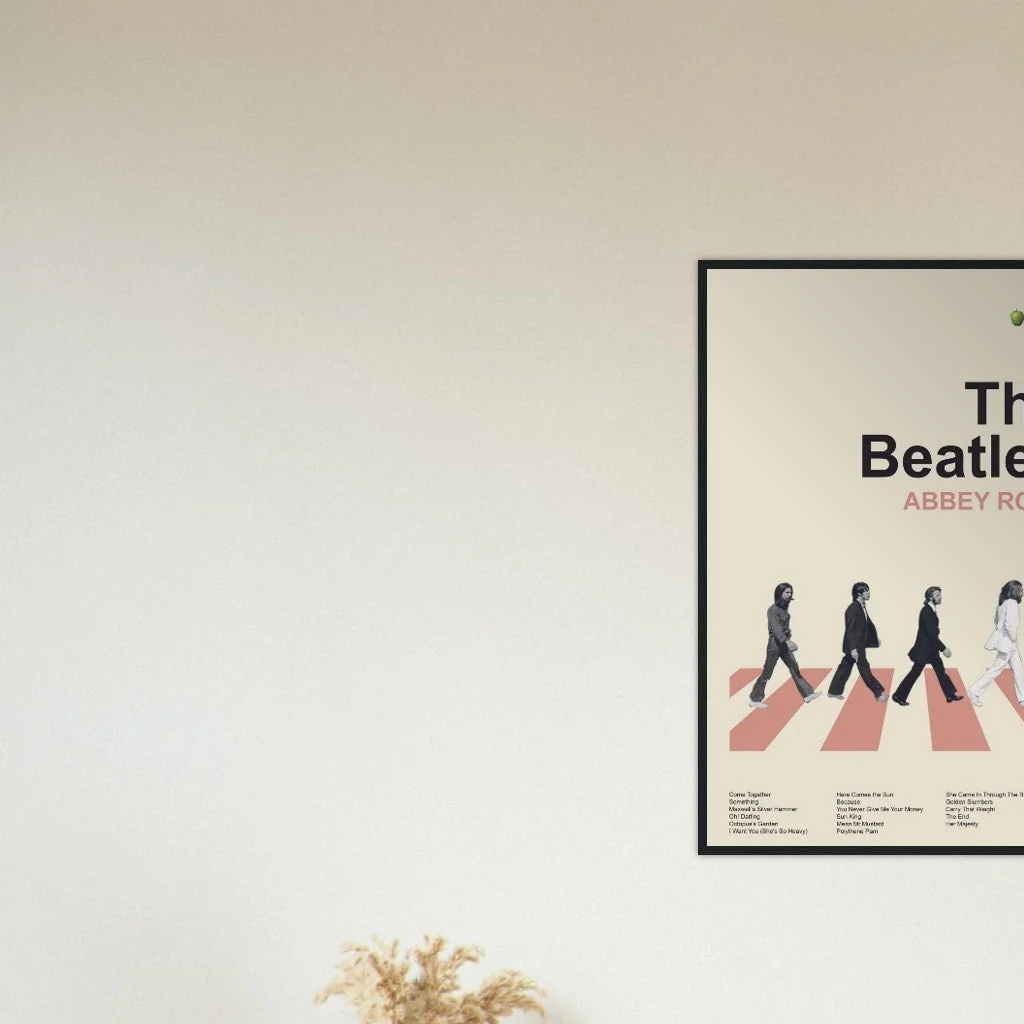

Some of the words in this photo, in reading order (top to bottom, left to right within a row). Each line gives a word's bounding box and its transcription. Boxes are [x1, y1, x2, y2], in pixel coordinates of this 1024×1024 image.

[903, 491, 990, 511] ABBEY
[746, 791, 771, 799] Together
[983, 791, 1007, 799] Through
